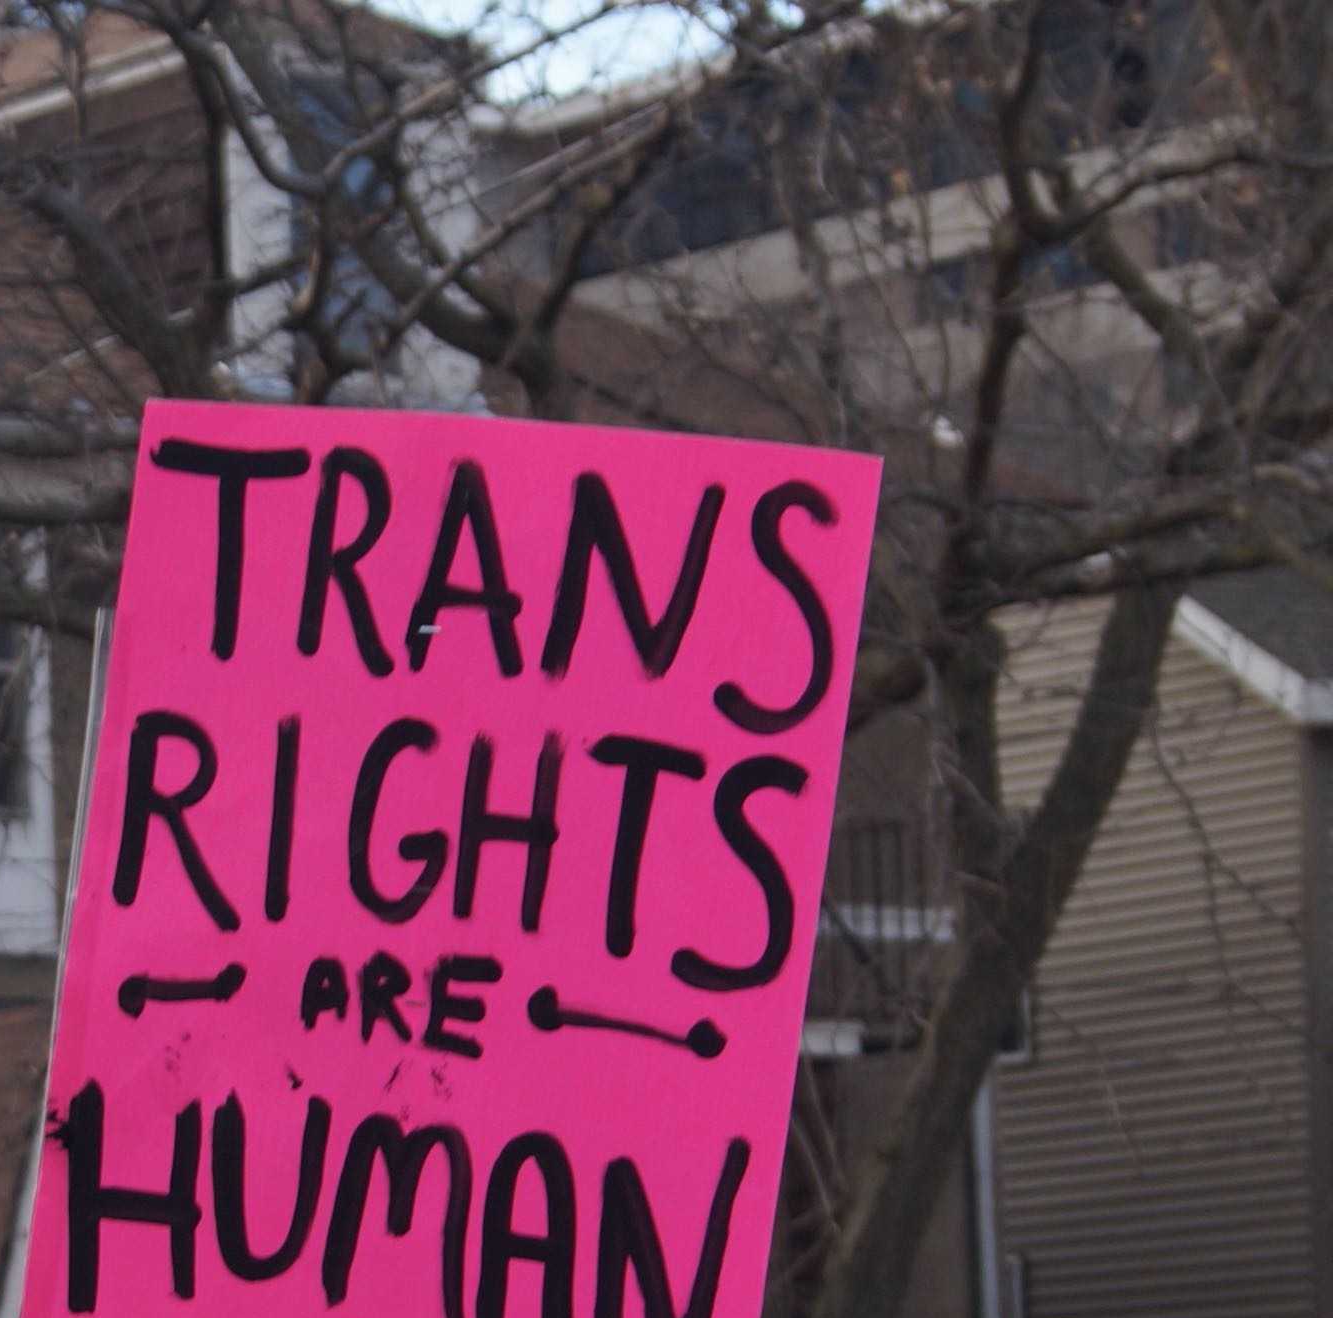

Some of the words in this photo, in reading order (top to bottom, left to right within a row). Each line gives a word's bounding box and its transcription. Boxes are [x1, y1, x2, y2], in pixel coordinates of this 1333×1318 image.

[150, 438, 839, 735] TRANS
[113, 711, 810, 992] RIGHTS
[300, 952, 502, 1058] ARE
